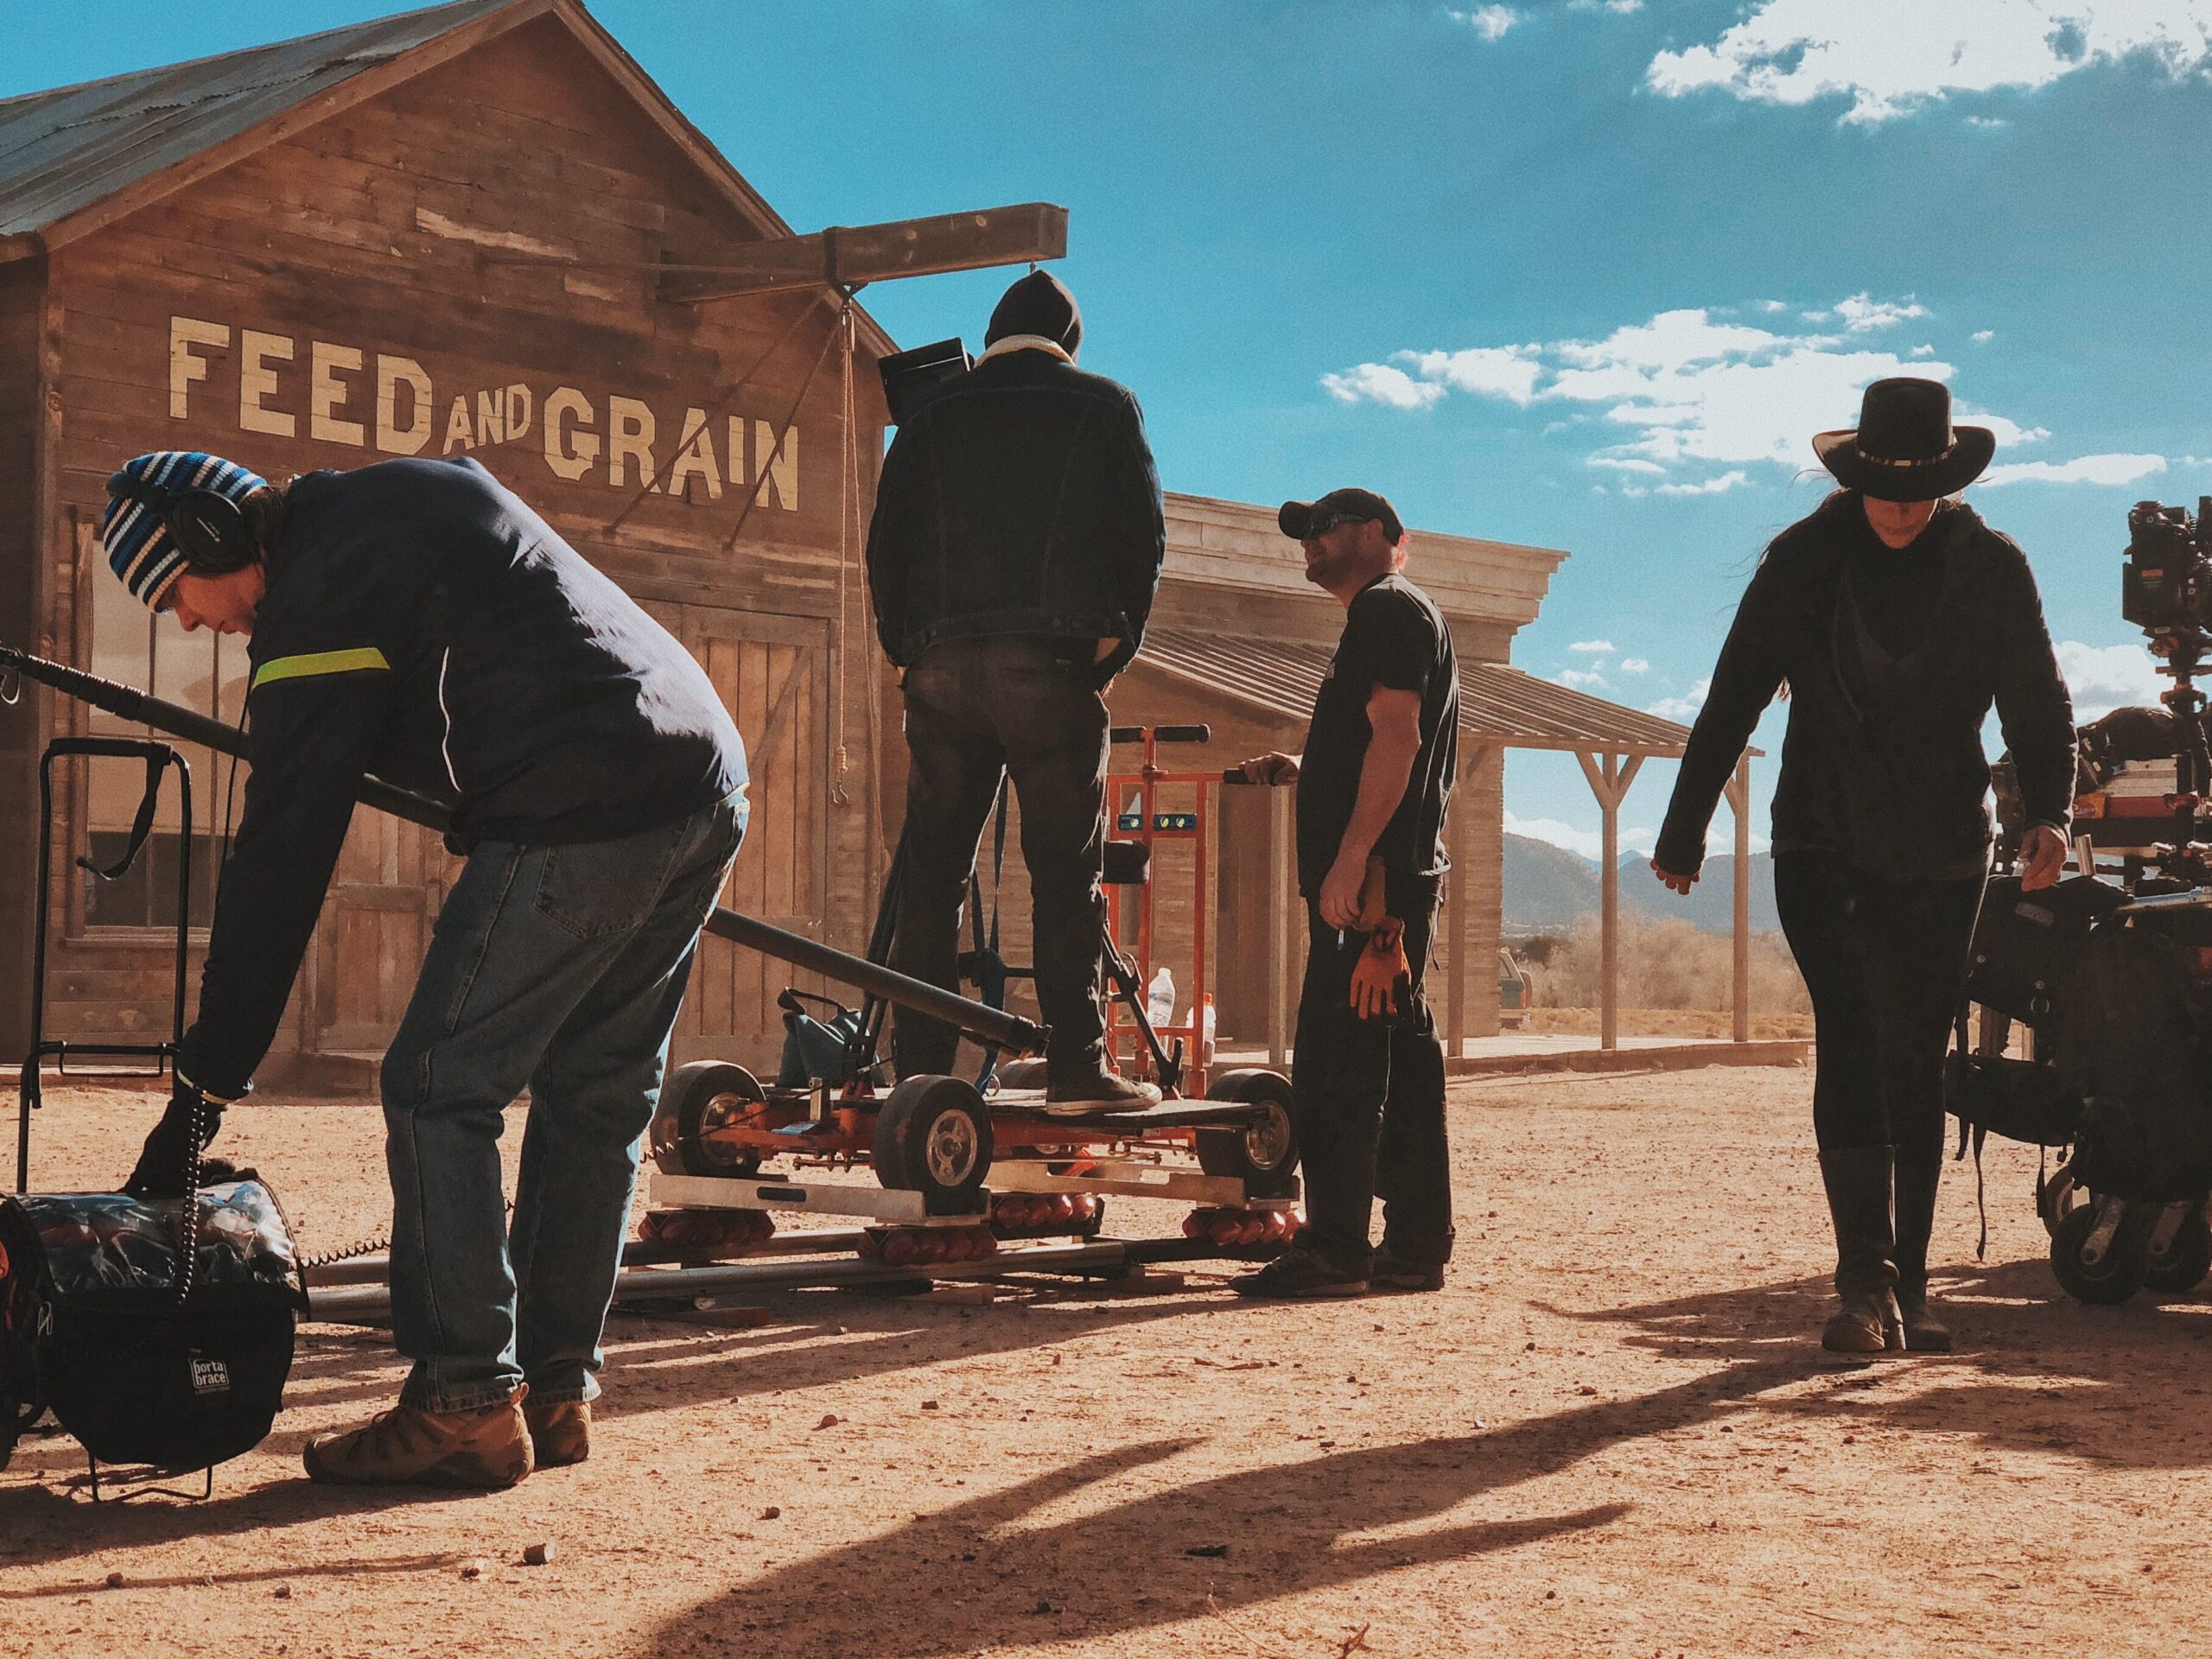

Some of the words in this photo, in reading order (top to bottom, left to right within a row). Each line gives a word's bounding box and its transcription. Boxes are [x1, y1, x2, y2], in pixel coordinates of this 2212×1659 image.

[168, 315, 434, 456] FEED
[442, 383, 533, 456] AND
[542, 385, 801, 513] GRAIN
[194, 1361, 224, 1374] porta
[195, 1373, 226, 1386] brace
